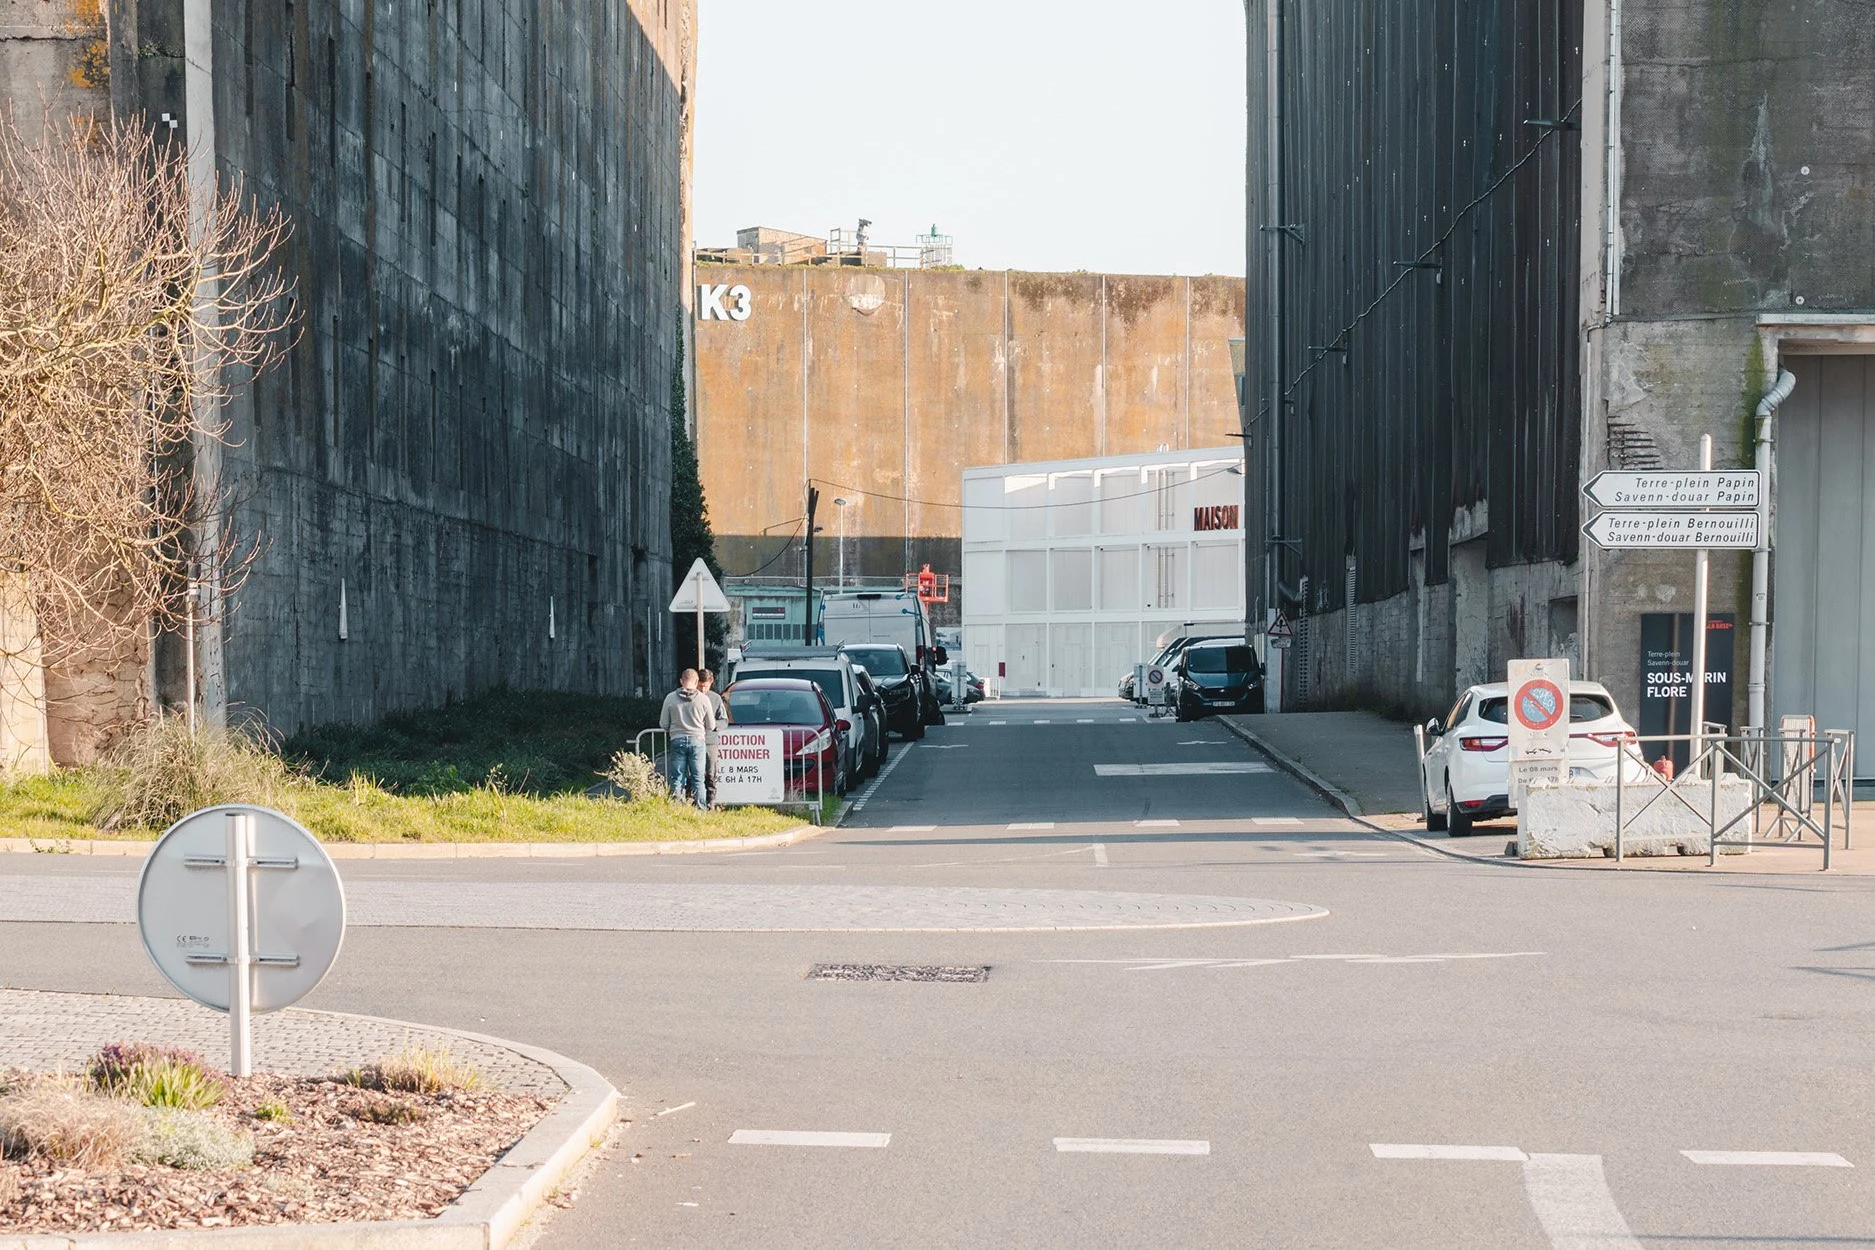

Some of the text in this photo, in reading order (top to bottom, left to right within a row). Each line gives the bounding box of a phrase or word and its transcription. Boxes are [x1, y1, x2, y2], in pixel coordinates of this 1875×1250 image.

[700, 283, 752, 321] K3
[1635, 477, 1754, 491] Terre-plein Papin
[1614, 491, 1754, 504] Savenn-douar Papin
[1194, 504, 1239, 532] MAISON
[1608, 517, 1754, 530] Terre-plein Bernouilli
[1607, 531, 1754, 543] Savenn-douar Bernouilli
[1647, 650, 1680, 658] Terre-plein
[1647, 672, 1727, 684] SOUS-MRIN
[1647, 686, 1687, 697] FLORE
[718, 734, 765, 745] DICTION
[718, 749, 770, 759] ATIONNER
